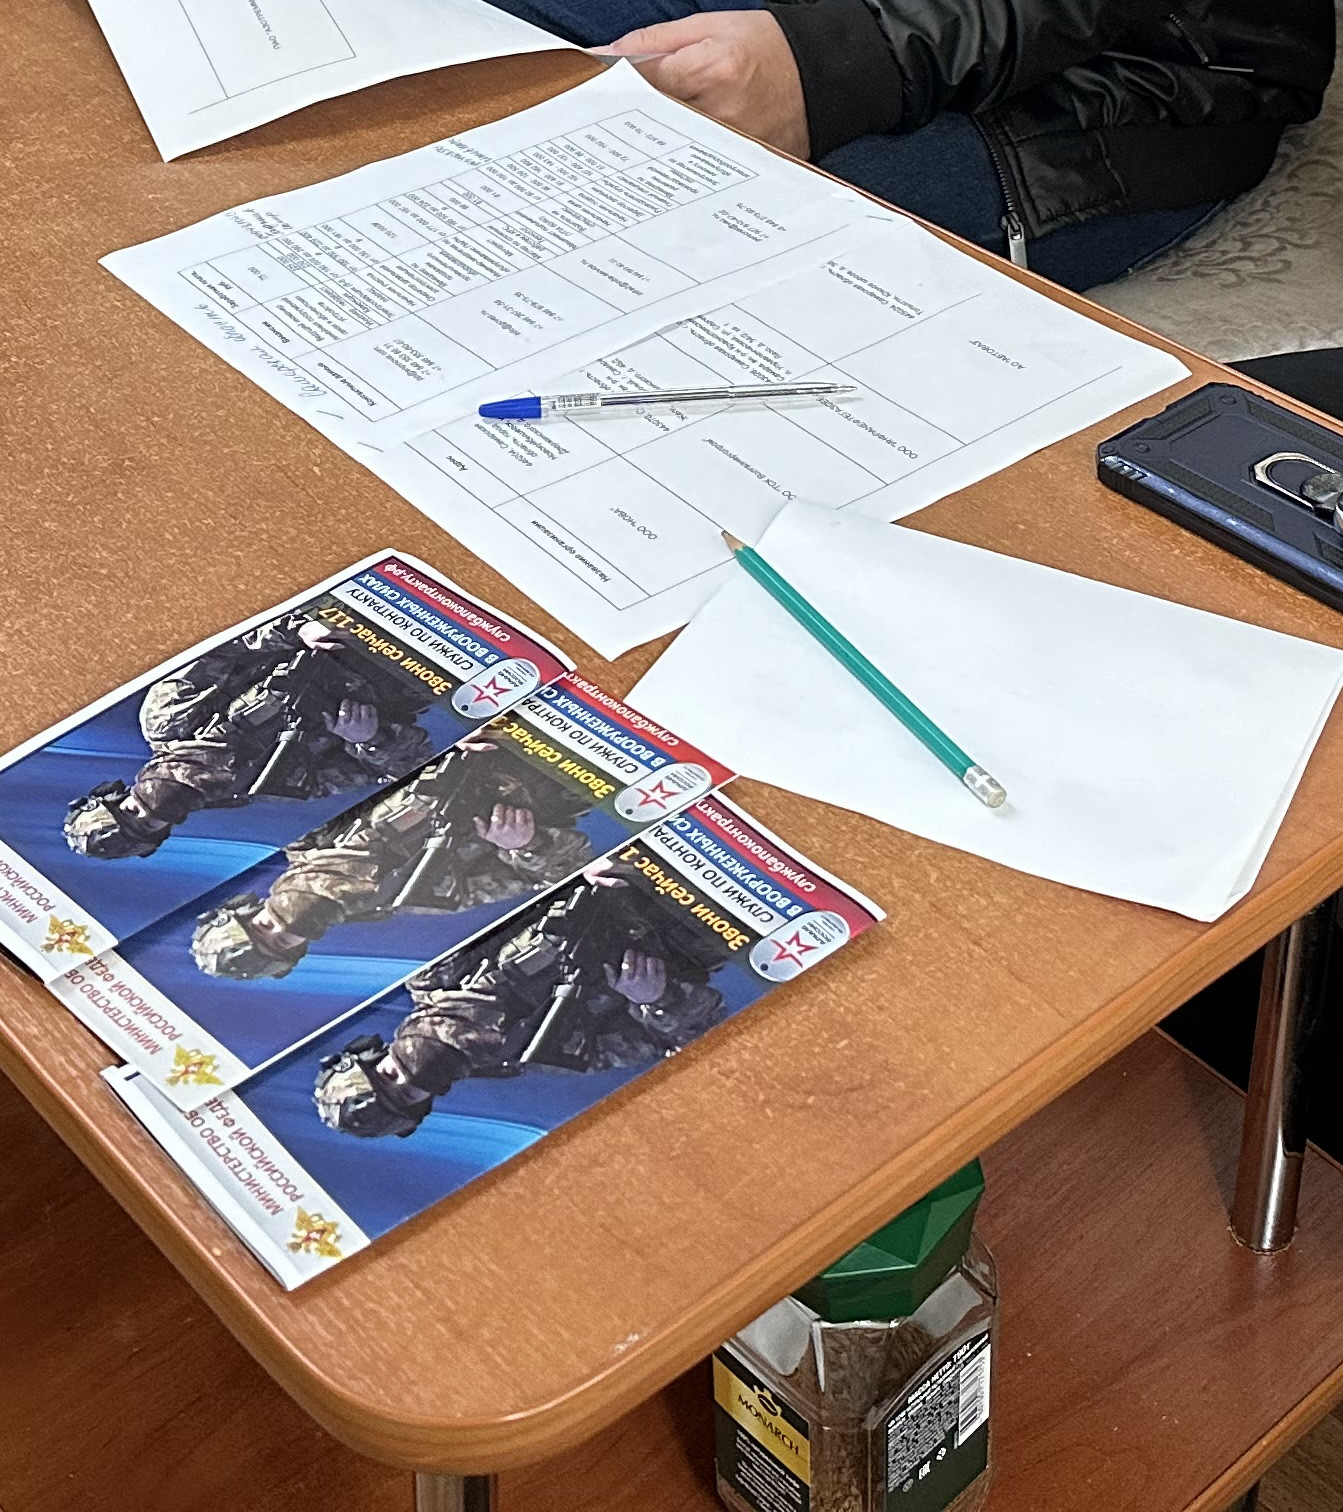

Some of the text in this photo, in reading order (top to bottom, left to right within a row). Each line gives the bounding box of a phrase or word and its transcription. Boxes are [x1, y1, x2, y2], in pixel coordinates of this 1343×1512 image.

[203, 283, 241, 309] Заработная
[849, 283, 890, 304] Самарская
[257, 320, 292, 343] Вакансии
[315, 361, 377, 406] Контактные данные
[1008, 360, 1027, 370] АО
[470, 422, 510, 449] Самарская
[895, 445, 920, 459] ООО
[442, 455, 469, 472] Адрес
[528, 519, 612, 582] Название организации
[635, 524, 659, 540] ООО
[343, 585, 415, 630] КОНТРАКТУ
[355, 572, 500, 664] В ВООРУЖЕННЫХ СИЛАХ
[379, 559, 515, 644] службапоконтракту.рф
[317, 604, 455, 696] Звони сейчас 117
[406, 626, 433, 643] ПО
[425, 638, 476, 671] СЛУЖИ
[550, 694, 667, 768] В ВООРУЖЕННЫХ
[560, 670, 684, 747] службапоконтракт
[497, 720, 618, 799] Звони сейчас
[518, 696, 641, 775] СЛУЖИ ПО КОНТРА
[647, 826, 707, 871] КОНТРА
[683, 828, 805, 916] В ВООРУЖЕННЫХ
[630, 855, 751, 951] Звони сейчас
[699, 868, 728, 888] ПО
[720, 885, 776, 924] СЛУЖИ
[75, 982, 163, 1055] МИНИСТЕРСТВО
[105, 980, 184, 1041] РОССИЙСКОЙ
[195, 1124, 286, 1217] МИНИСТЕРСТВО
[225, 1125, 305, 1204] РОССИЙСКОЙ
[737, 1392, 800, 1456] MONARCH
